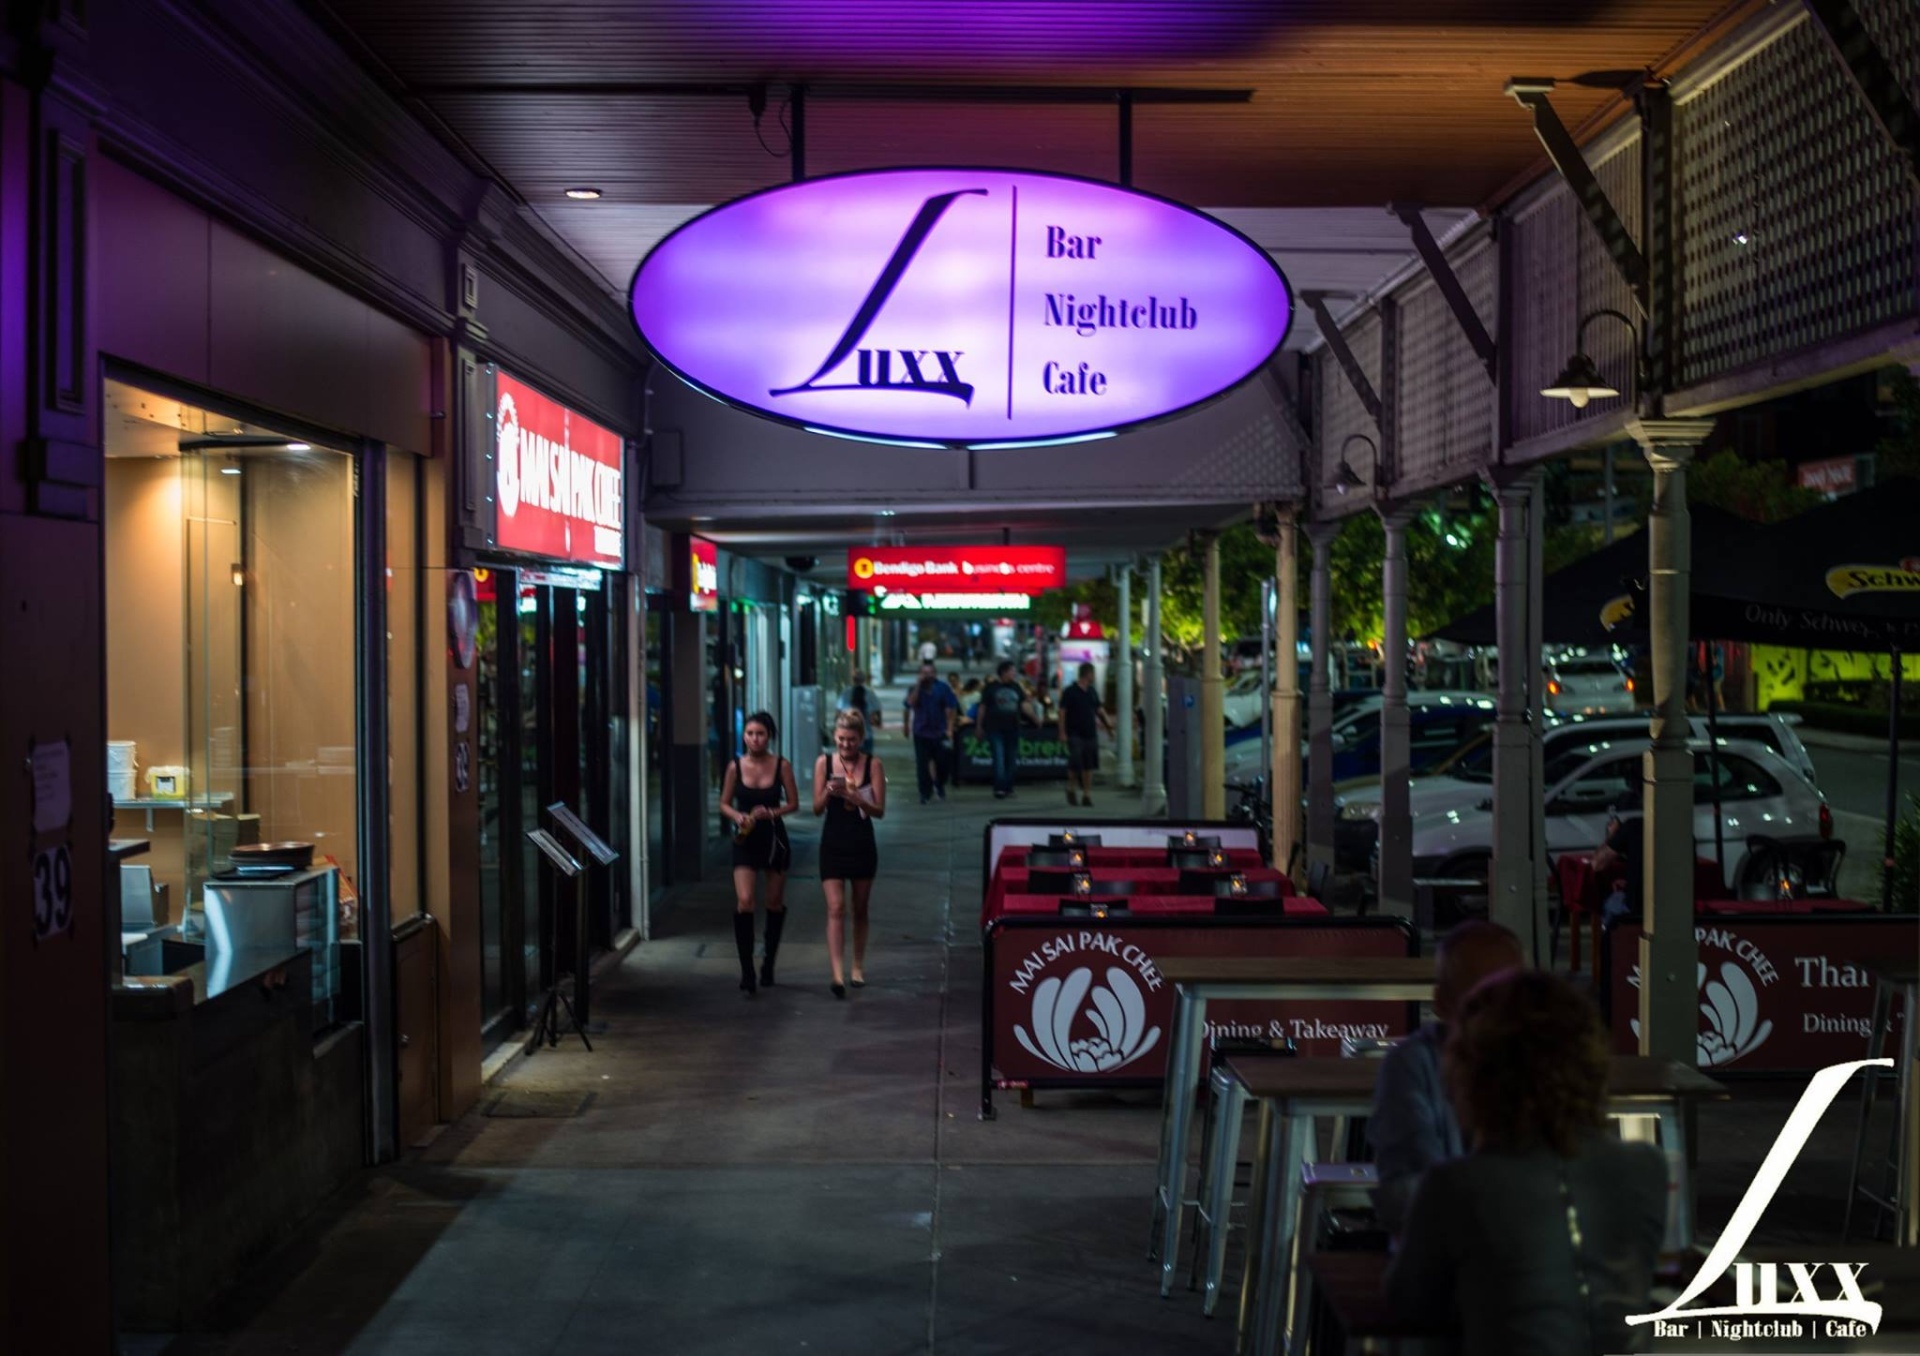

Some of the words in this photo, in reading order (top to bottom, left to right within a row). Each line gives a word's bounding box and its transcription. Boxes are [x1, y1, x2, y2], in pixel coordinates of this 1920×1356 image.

[1045, 225, 1102, 260] Bar
[768, 187, 988, 409] Luxx
[1043, 293, 1198, 337] Nightclub
[1043, 360, 1108, 396] Cafe
[34, 846, 71, 937] 39
[1008, 951, 1046, 995] MAI
[1041, 933, 1076, 962] SAI
[1079, 930, 1124, 957] PAK
[1121, 944, 1164, 993] CHEE
[1735, 939, 1780, 988] CHEE
[1268, 1019, 1285, 1039] &
[1803, 1012, 1873, 1039] Dining
